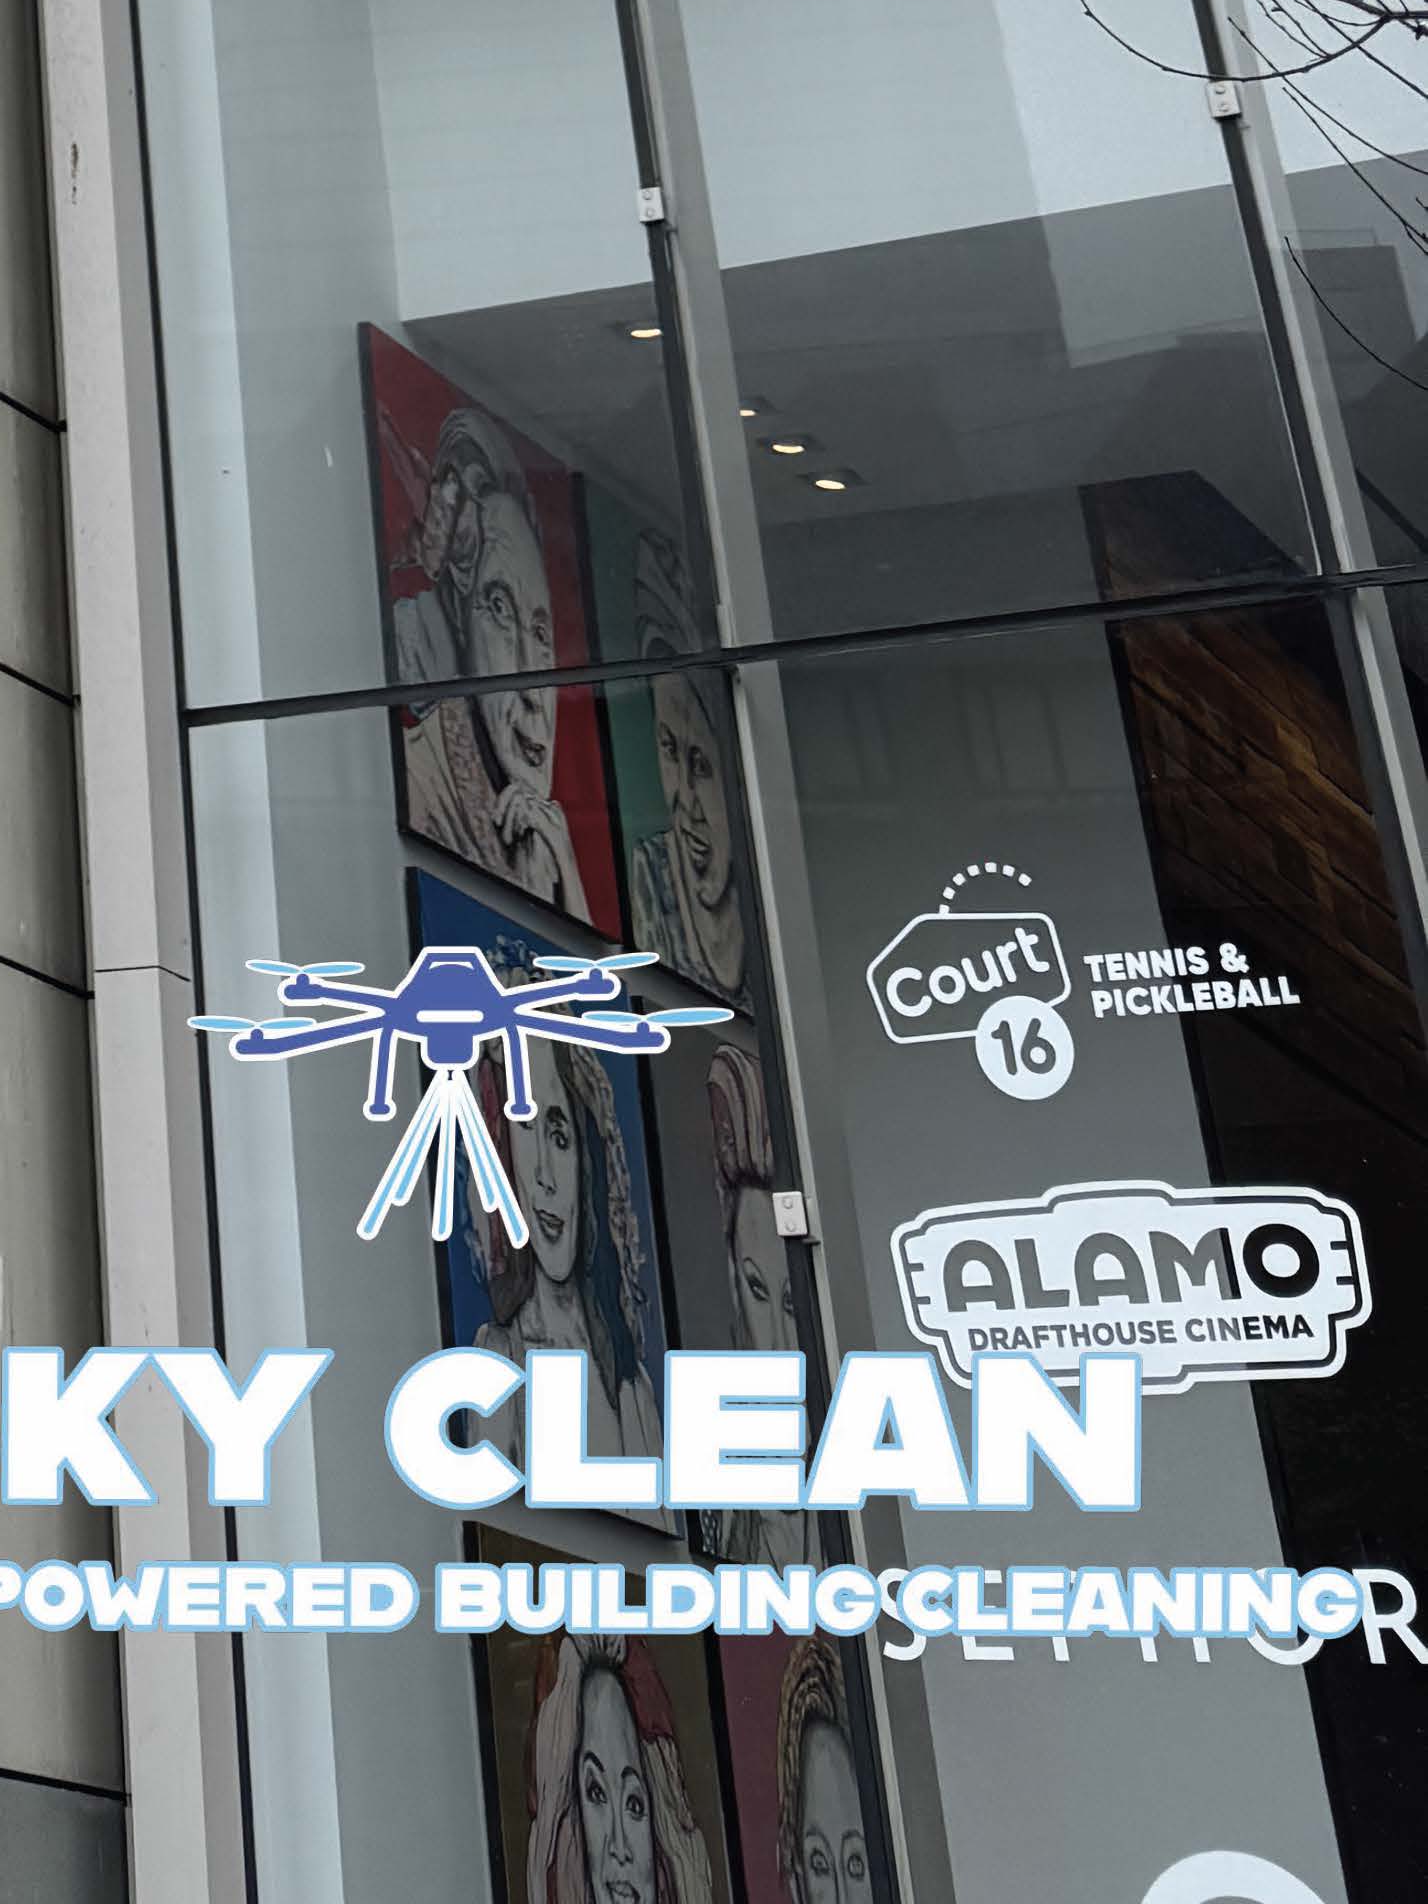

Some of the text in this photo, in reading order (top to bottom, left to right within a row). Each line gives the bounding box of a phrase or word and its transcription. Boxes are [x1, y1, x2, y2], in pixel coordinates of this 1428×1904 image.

[886, 927, 1050, 1017] Court
[1083, 942, 1249, 982] TENNIS &
[1090, 976, 1301, 1018] PICKLEBALL
[991, 1018, 1056, 1075] 16
[943, 1223, 1320, 1312] ALAMO
[968, 1314, 1315, 1351] DRAFTHOUSE CINEMA
